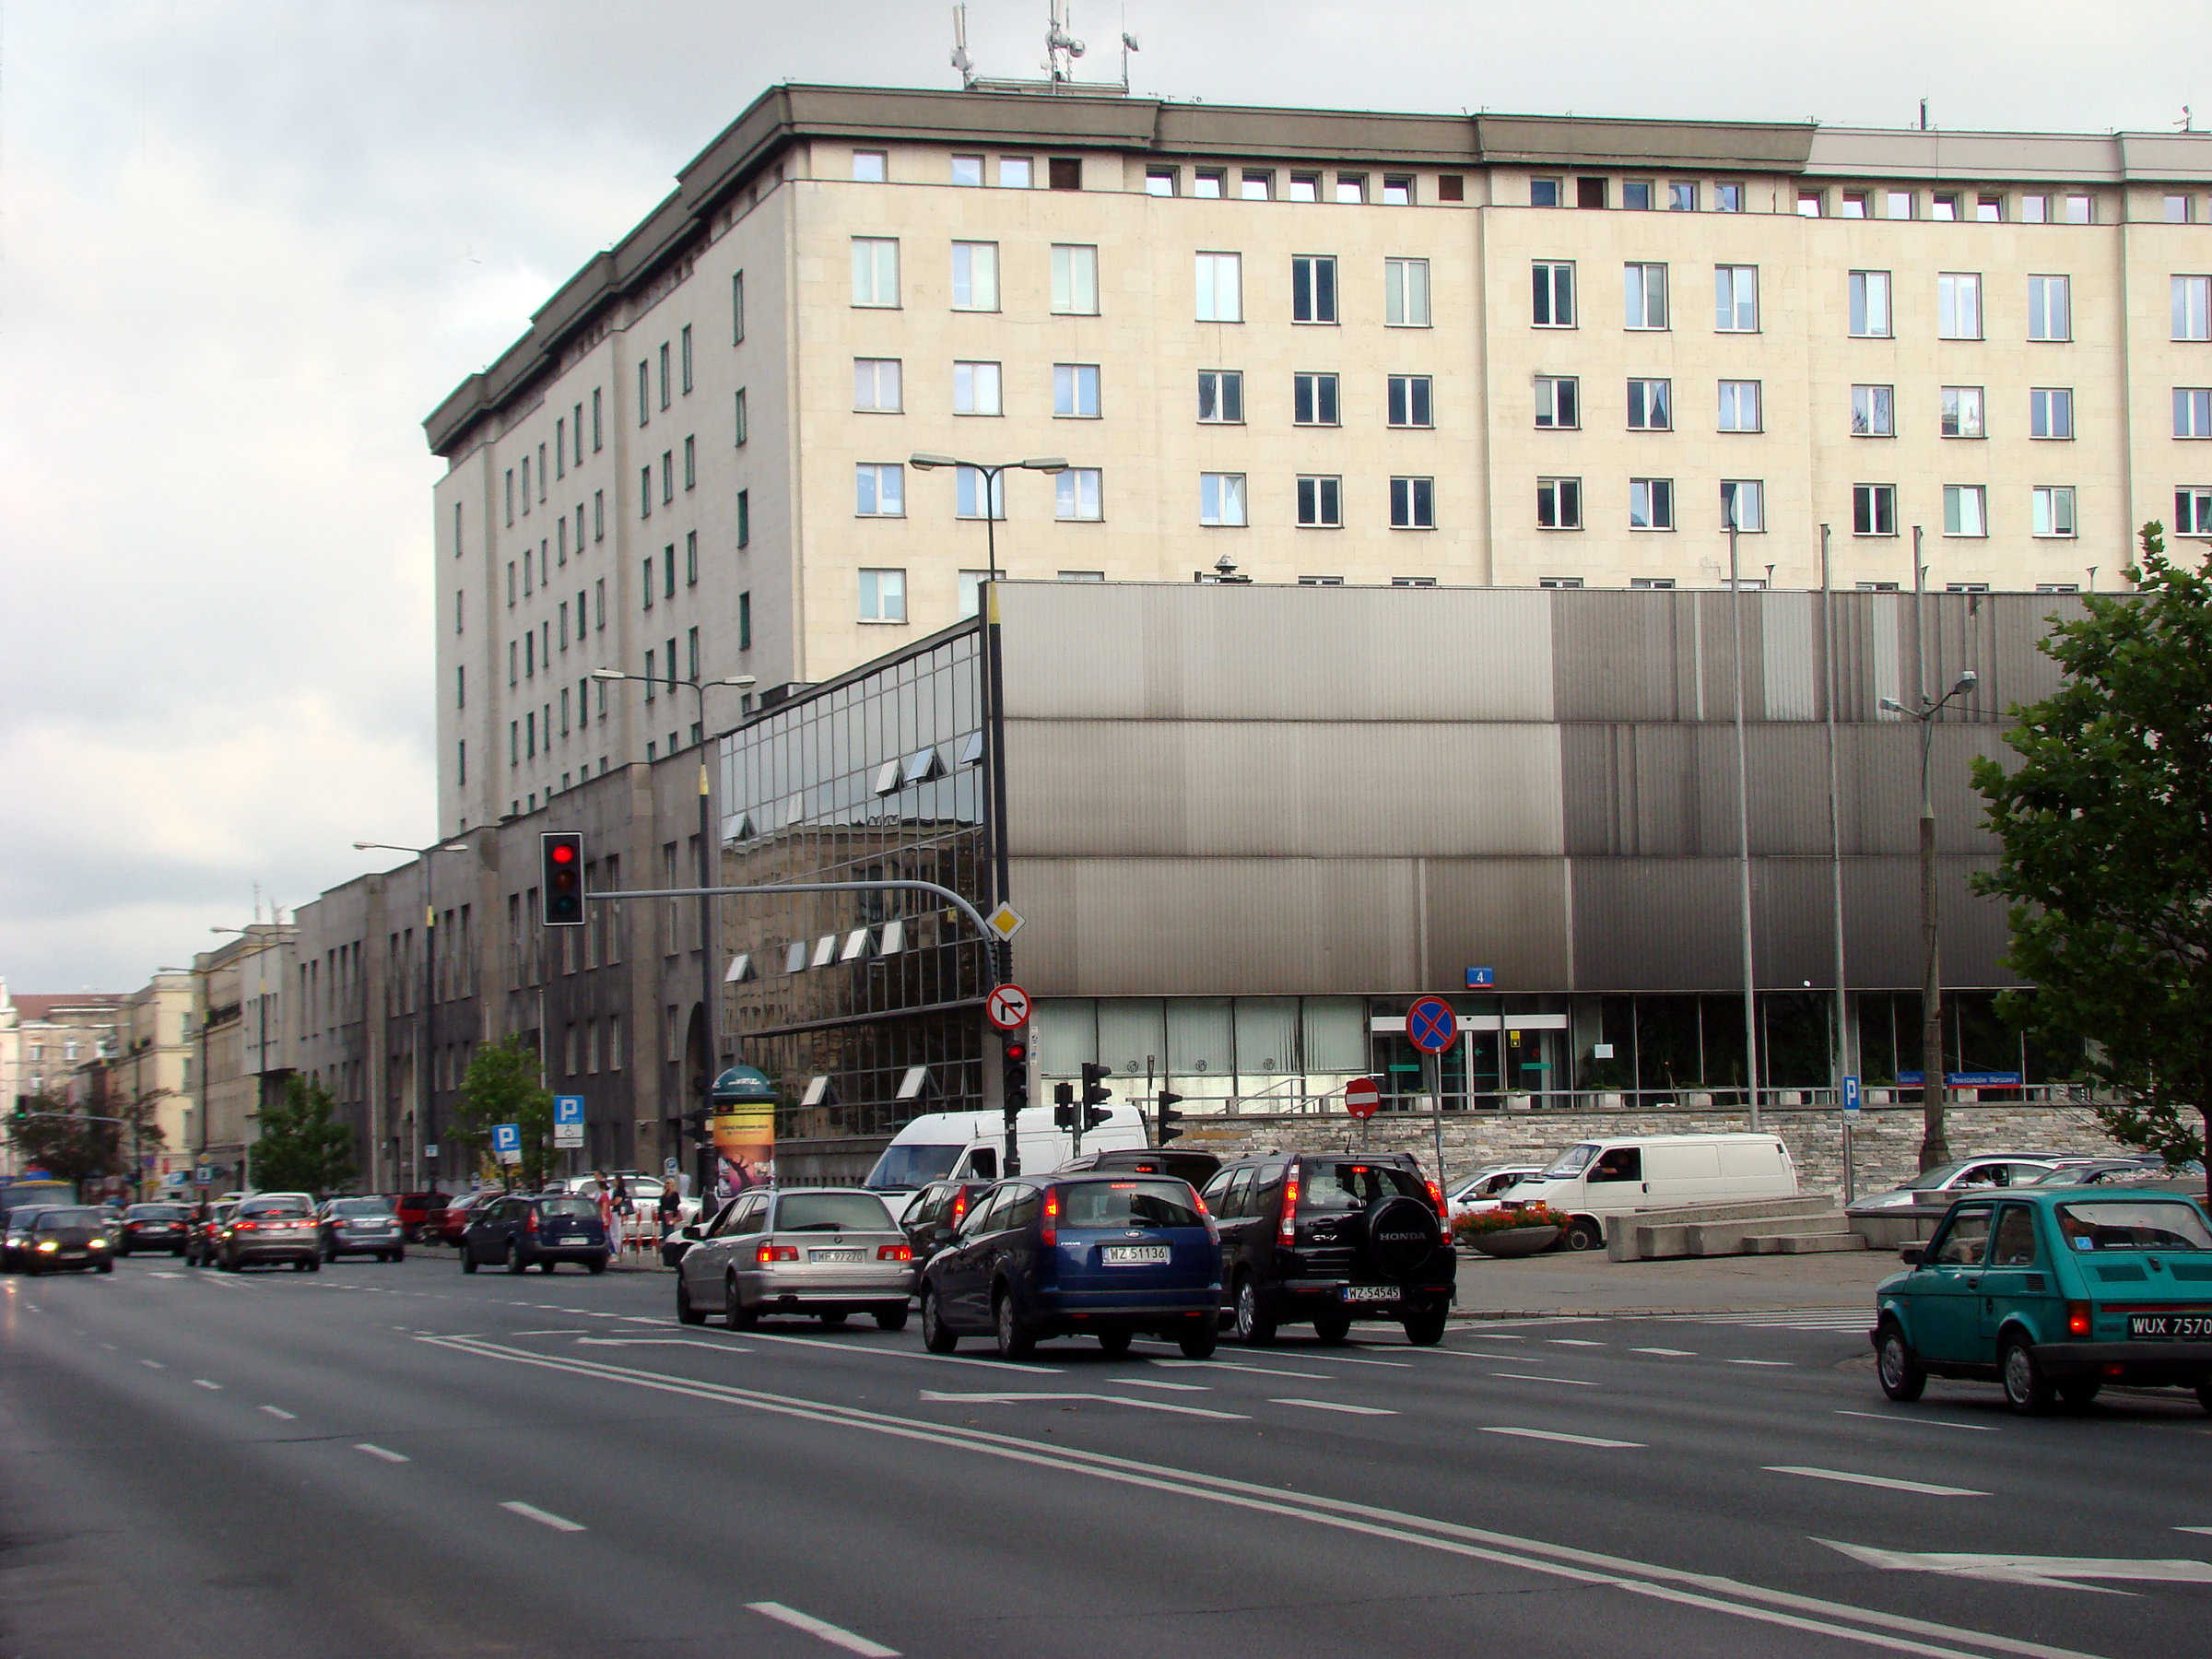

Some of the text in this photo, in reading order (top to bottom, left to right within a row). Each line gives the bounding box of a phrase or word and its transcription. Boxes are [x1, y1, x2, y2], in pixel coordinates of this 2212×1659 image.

[1476, 971, 1485, 983] 4
[1846, 1079, 1856, 1106] P
[559, 1099, 578, 1122] P
[498, 1127, 515, 1149] P
[1379, 1232, 1427, 1241] HONDA
[1110, 1246, 1166, 1260] WZ 51136
[1348, 1287, 1400, 1300] WZ 54545
[2132, 1317, 2212, 1335] WUX 7570
